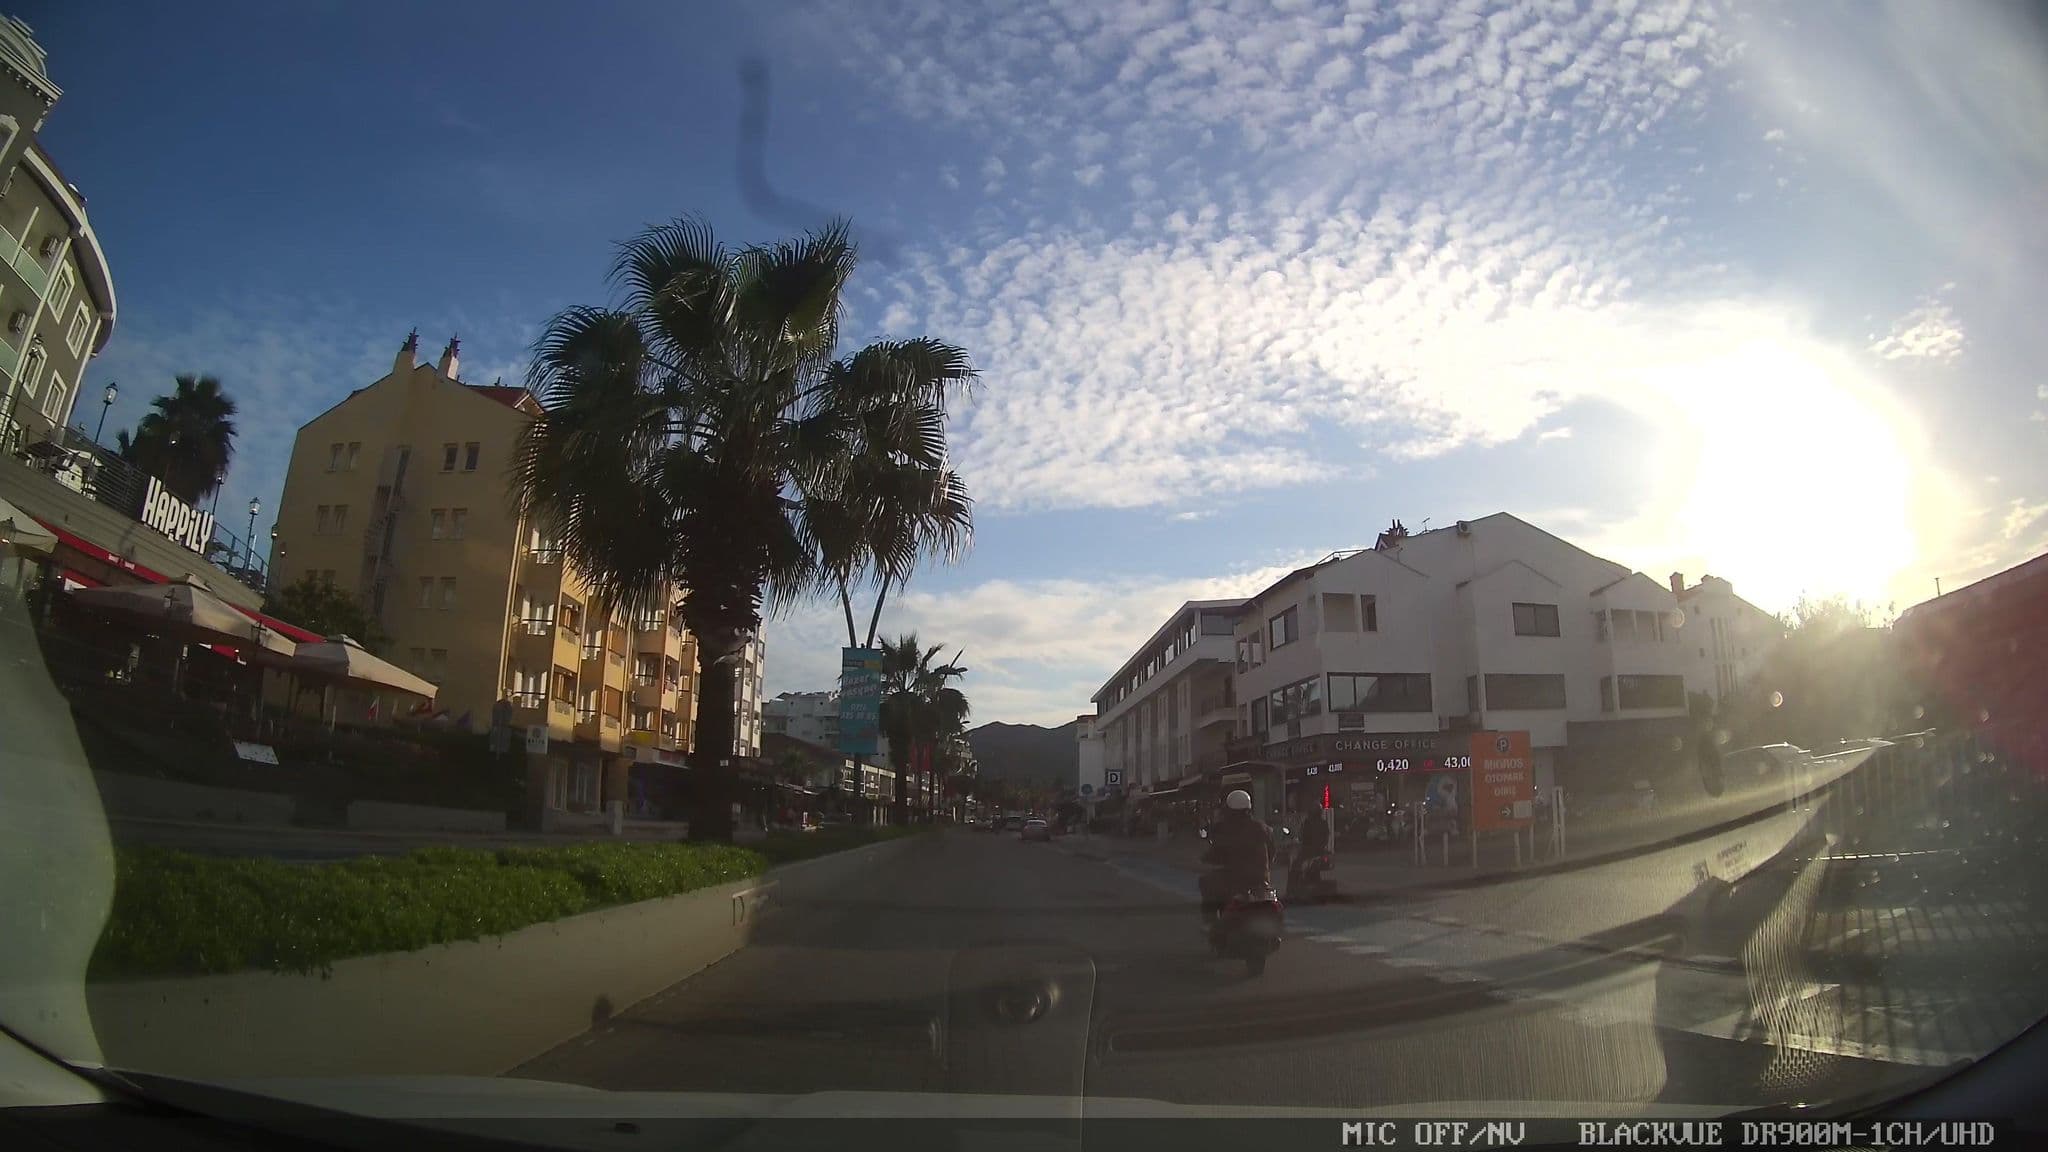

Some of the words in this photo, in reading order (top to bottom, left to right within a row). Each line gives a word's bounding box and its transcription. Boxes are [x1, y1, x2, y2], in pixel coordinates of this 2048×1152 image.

[1335, 740, 1388, 751] CHANGE
[1394, 739, 1437, 750] OFFICE
[1376, 759, 1409, 773] 0,420
[1110, 773, 1118, 783] D
